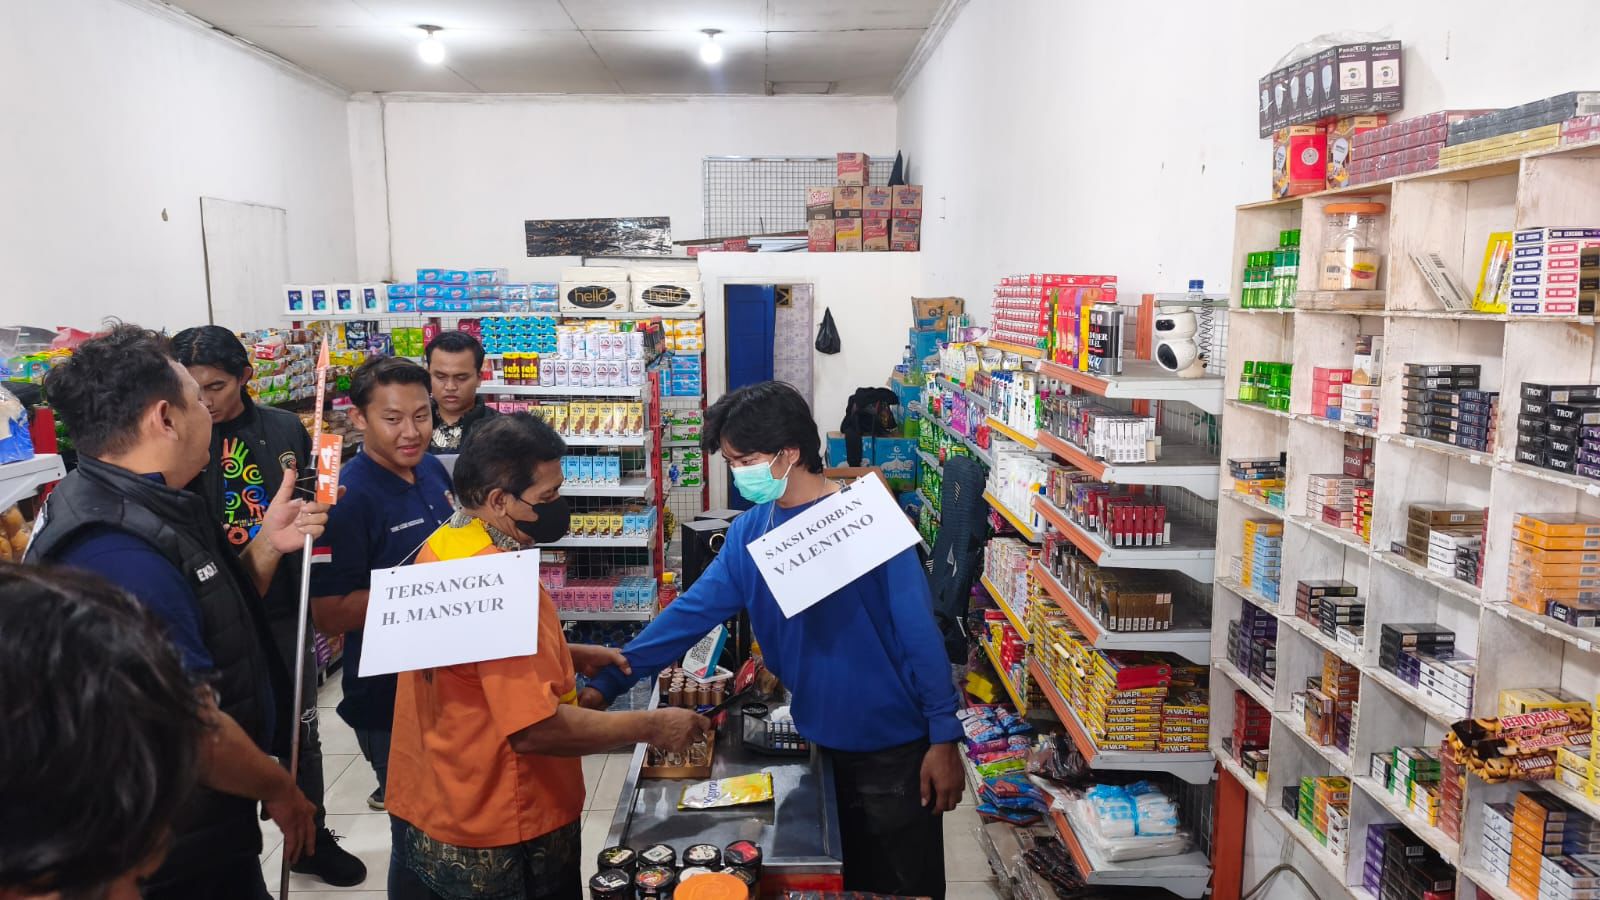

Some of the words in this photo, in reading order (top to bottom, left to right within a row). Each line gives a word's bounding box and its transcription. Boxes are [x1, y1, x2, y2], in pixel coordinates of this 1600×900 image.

[574, 288, 609, 304] hello
[1527, 387, 1541, 397] TROY
[1527, 404, 1541, 413] TROY
[1556, 408, 1574, 419] TROY
[1552, 441, 1568, 452] TROY
[1521, 451, 1536, 462] TROY
[1551, 458, 1567, 469] TROY
[765, 531, 805, 560] SAKSI
[806, 498, 864, 536] KORBAN
[773, 513, 874, 577] VALENTINO
[385, 572, 505, 601] TERSANGKA
[382, 610, 401, 627] H.
[405, 597, 505, 624] MANSYUR
